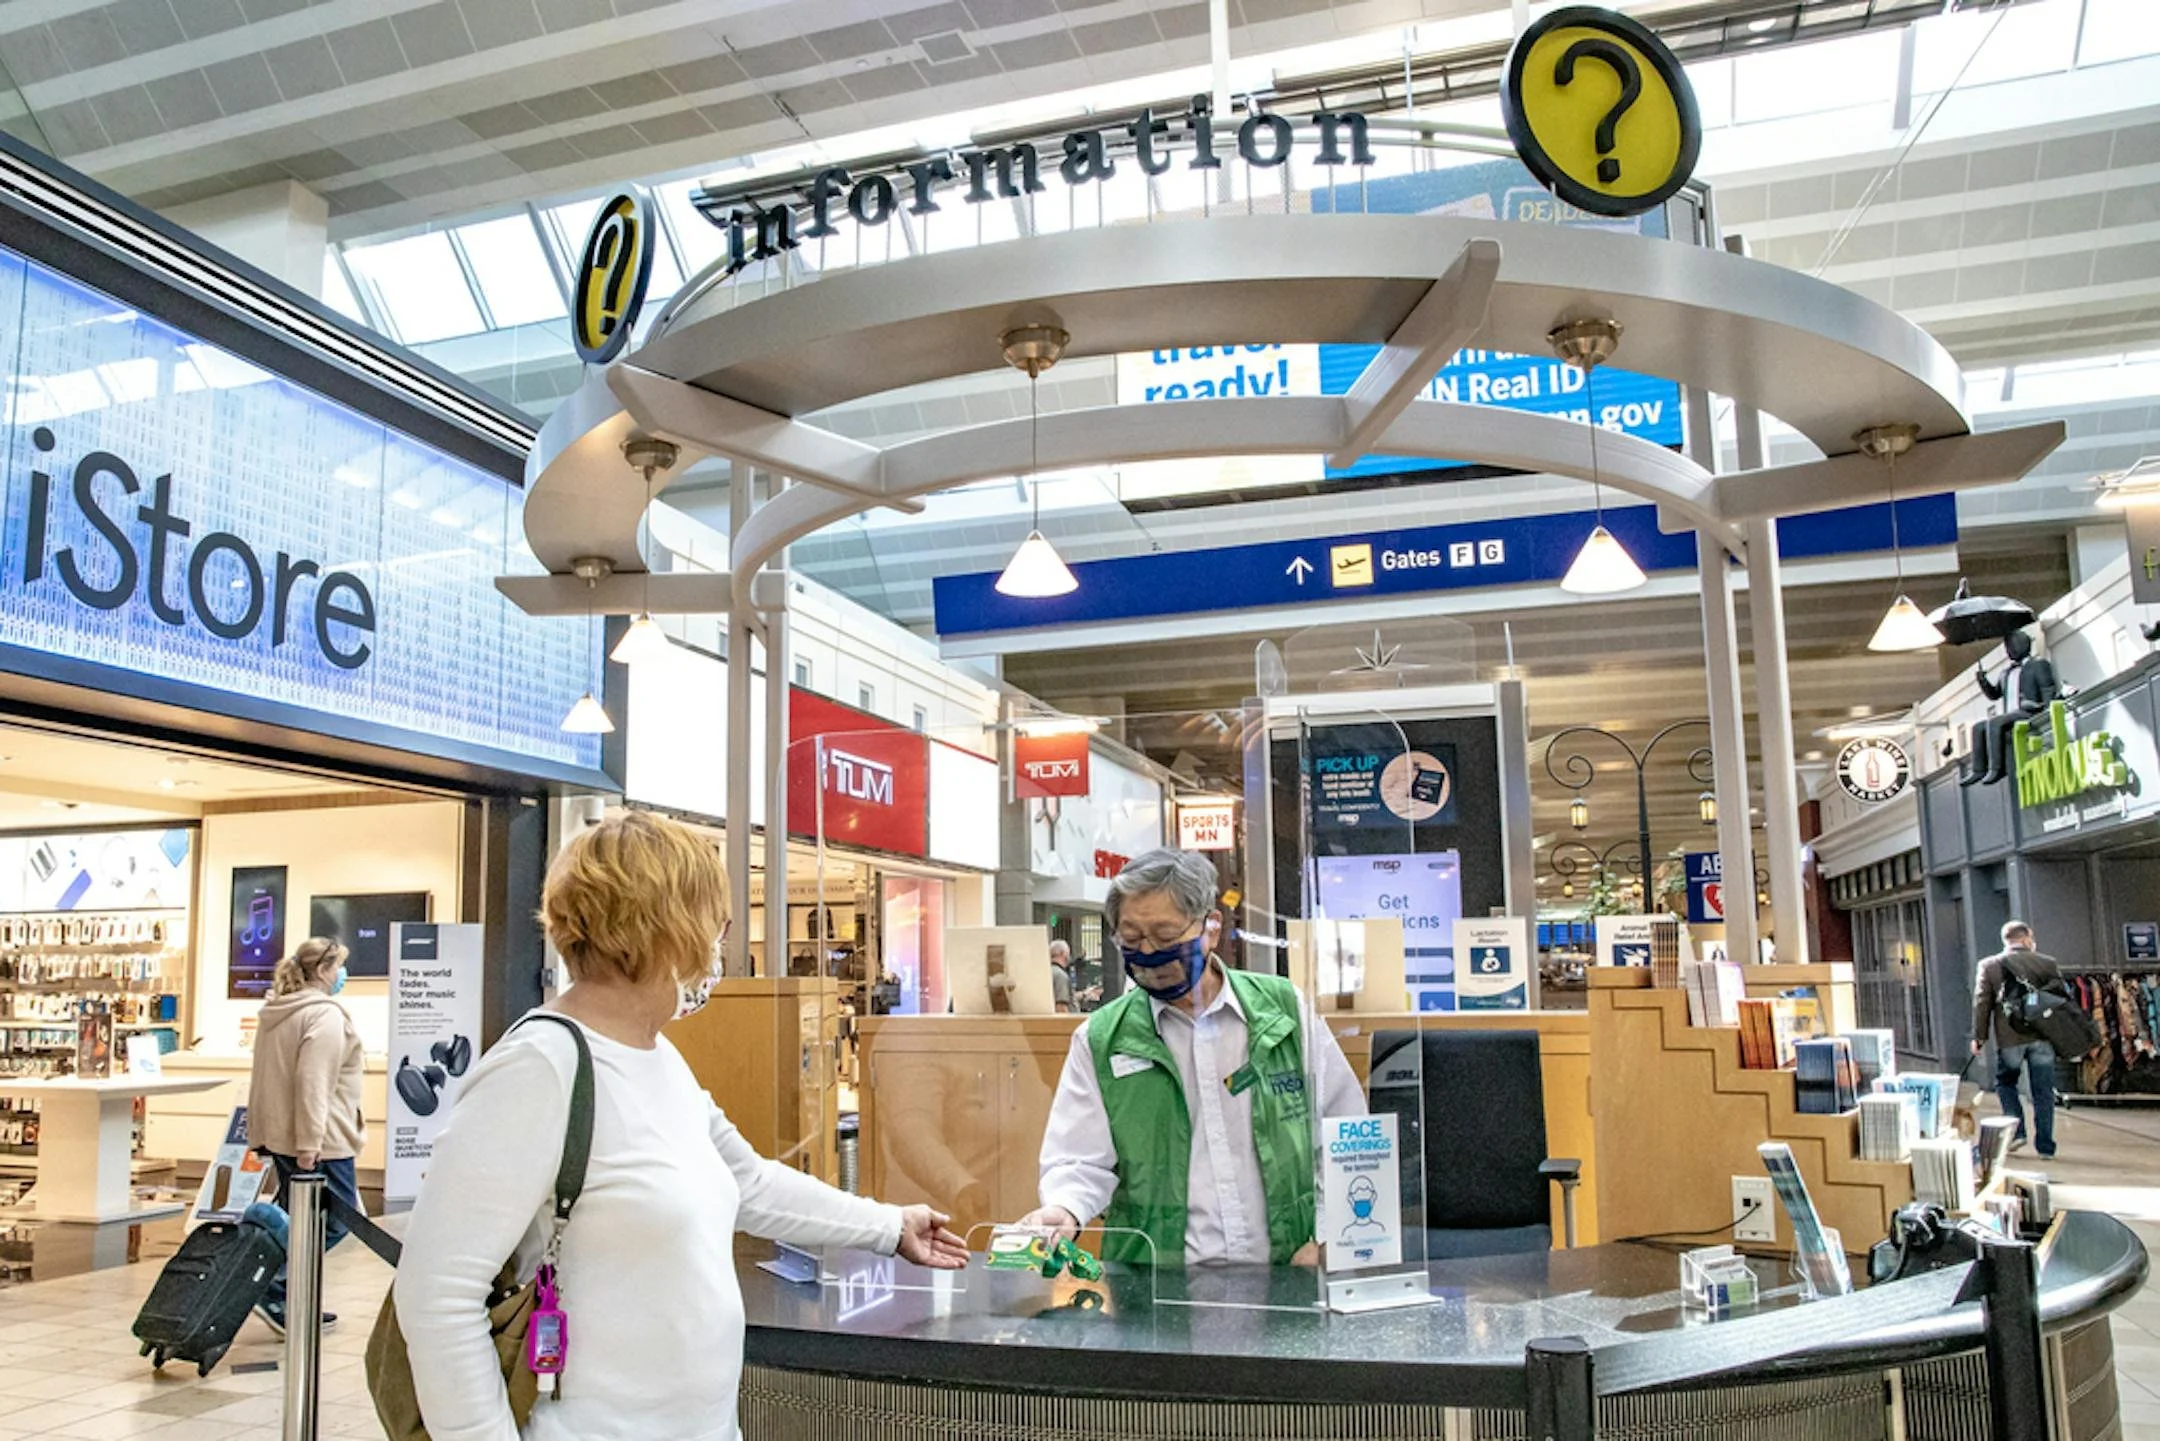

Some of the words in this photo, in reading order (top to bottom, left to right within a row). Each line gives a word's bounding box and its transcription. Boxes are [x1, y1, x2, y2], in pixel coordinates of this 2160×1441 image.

[726, 92, 1375, 274] information
[1468, 366, 1540, 402] Real
[1549, 364, 1586, 395] ID
[24, 426, 375, 669] iStore
[1380, 549, 1441, 570] Gates
[1316, 757, 1354, 773] PICK
[1356, 754, 1380, 771] UP
[1183, 814, 1230, 829] SPORTS
[1194, 829, 1218, 843] MN
[1372, 859, 1402, 872] msp
[1378, 893, 1409, 910] Get
[400, 969, 420, 977] The
[422, 968, 452, 978] world
[399, 979, 431, 989] fades.
[400, 990, 423, 999] Your
[426, 989, 456, 999] music
[399, 1000, 435, 1010] shines.
[1338, 1119, 1383, 1140] FACE
[1329, 1137, 1392, 1154] COVERINGS
